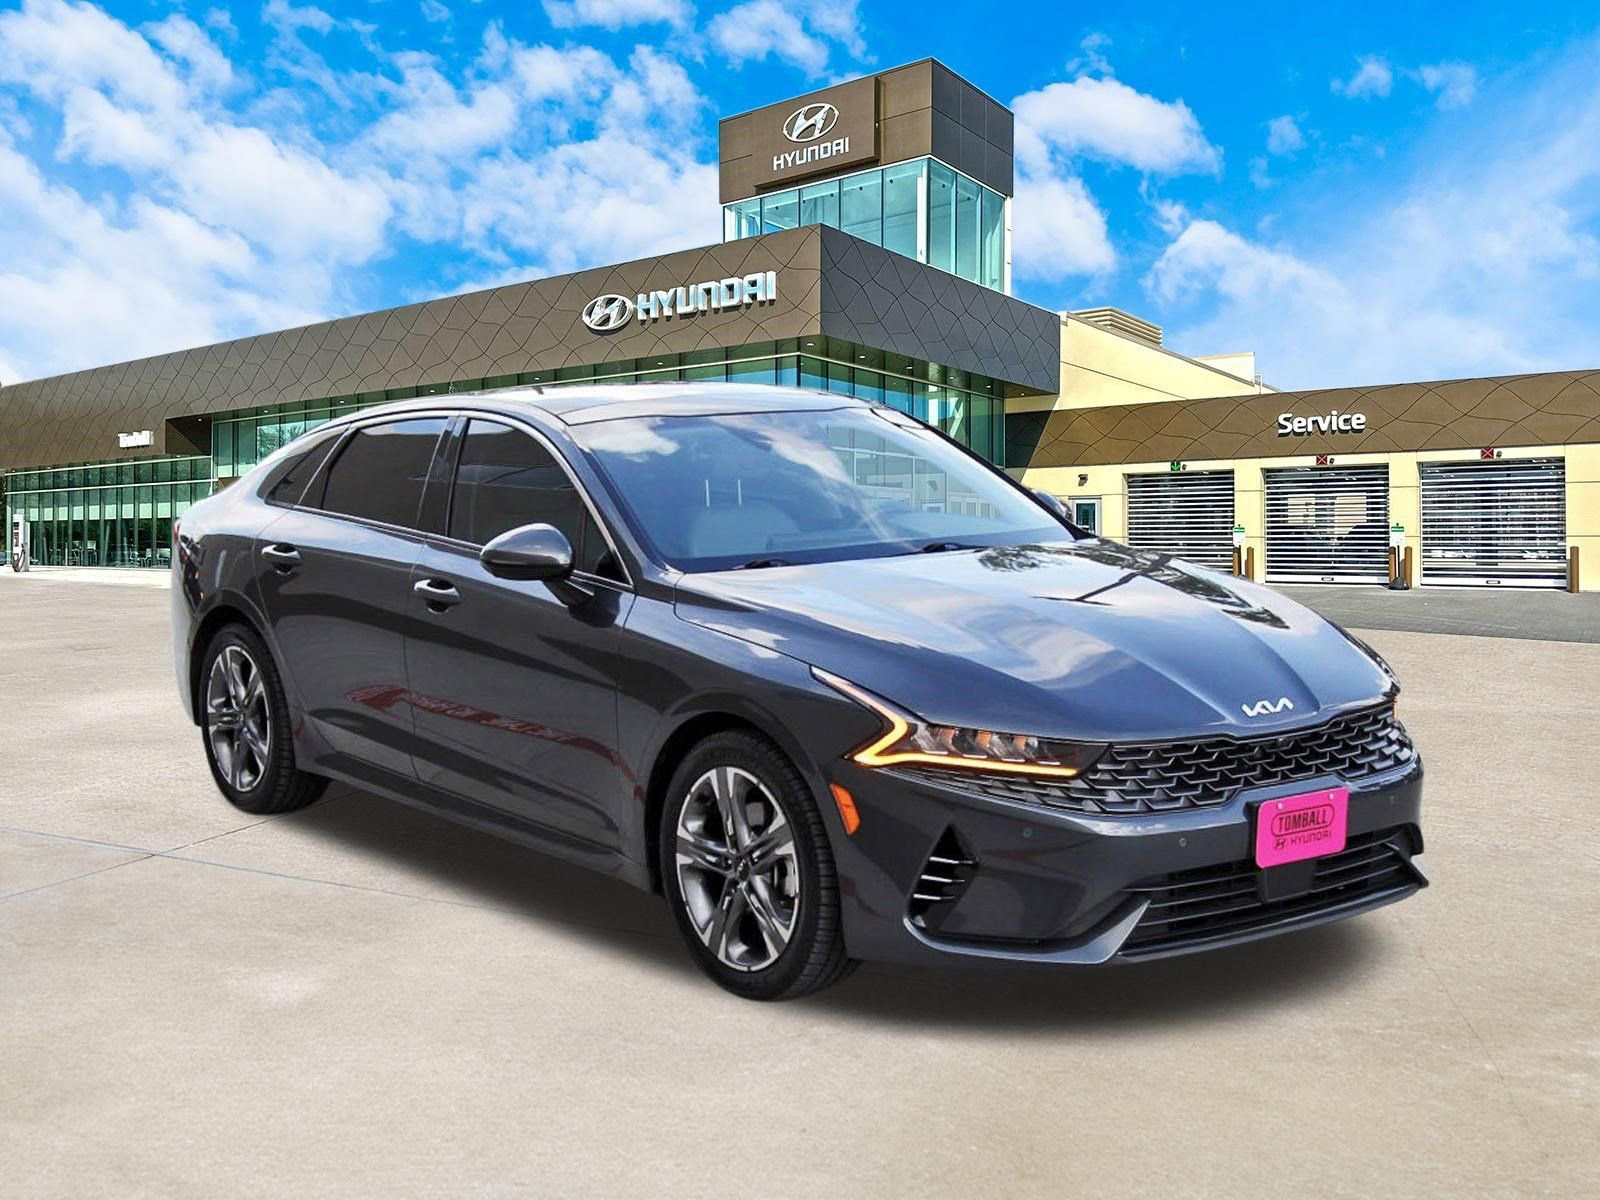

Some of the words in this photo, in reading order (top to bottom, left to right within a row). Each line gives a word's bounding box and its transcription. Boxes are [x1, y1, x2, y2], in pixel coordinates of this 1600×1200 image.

[773, 137, 850, 171] HYUNDAI
[637, 271, 777, 321] HYUNDAI
[1277, 410, 1367, 434] Service
[1278, 808, 1328, 834] TOMBALL
[1290, 830, 1332, 846] HYUNDAI
